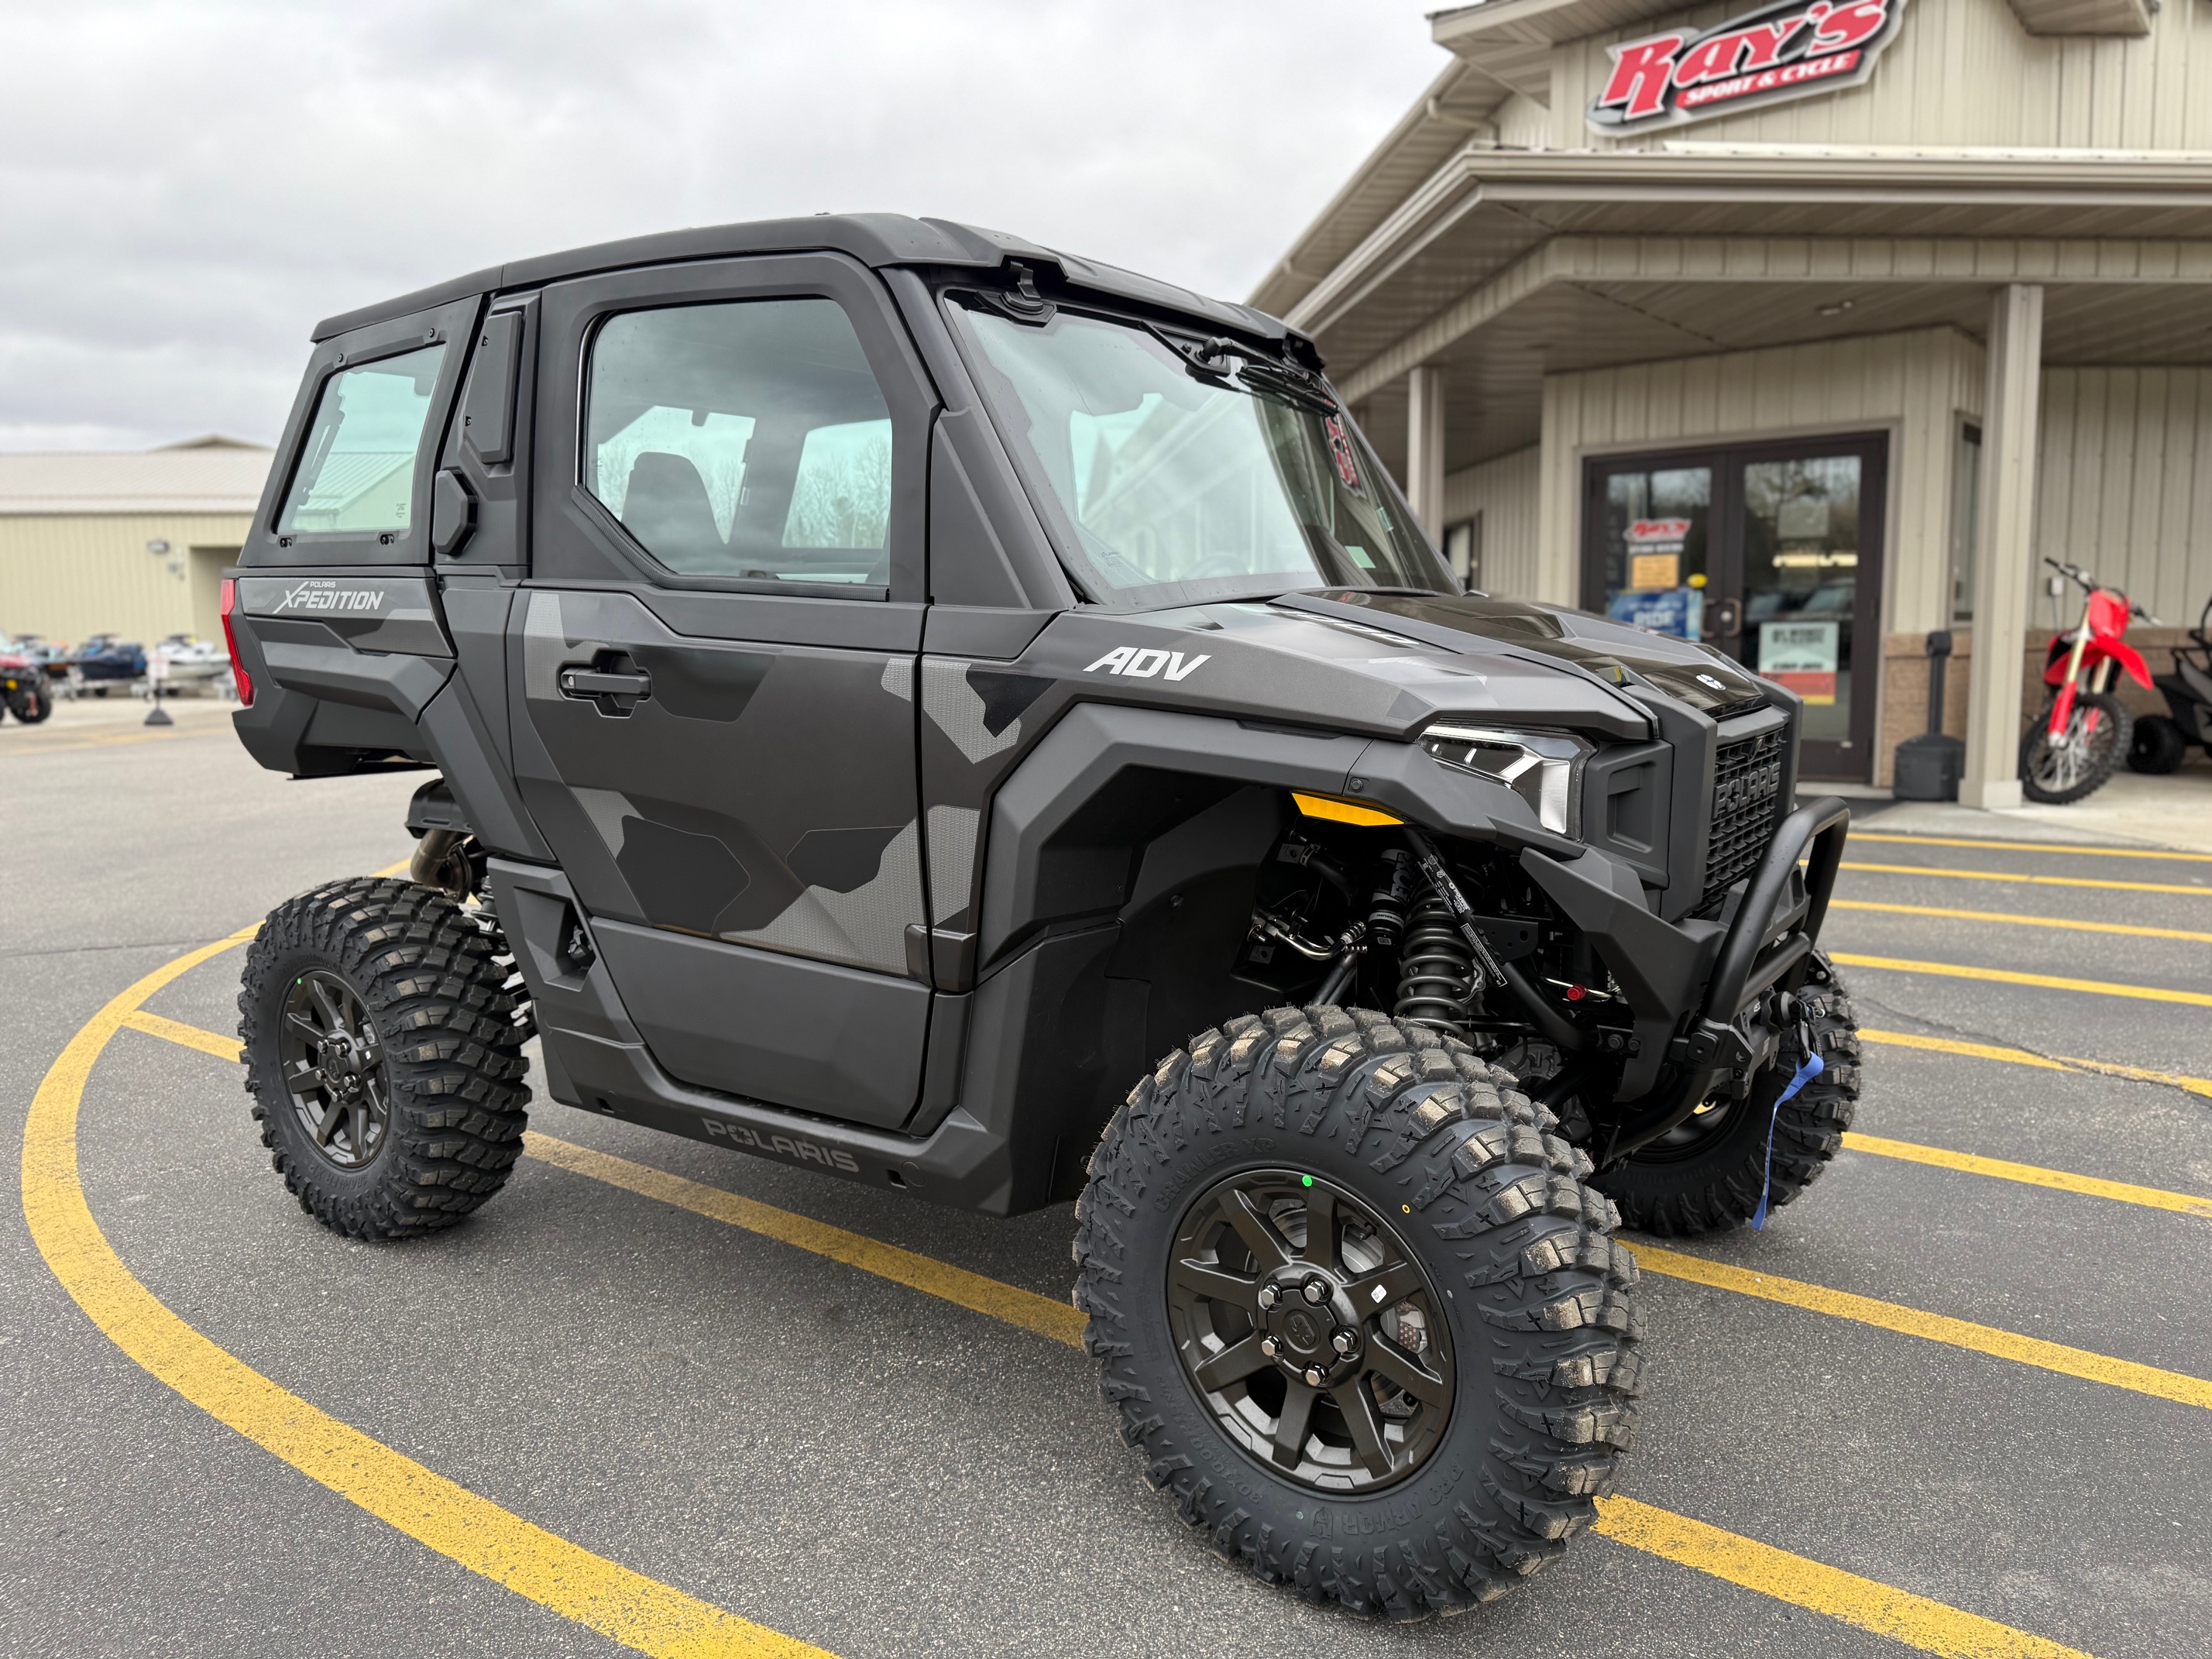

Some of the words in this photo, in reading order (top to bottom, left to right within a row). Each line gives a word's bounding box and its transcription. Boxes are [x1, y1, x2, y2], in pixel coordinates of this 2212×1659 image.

[1684, 76, 1755, 105] SPORT
[1757, 70, 1776, 88] &
[1781, 53, 1853, 82] CYCLE
[272, 581, 384, 614] XPEDITION
[1082, 646, 1212, 682] ADV
[1712, 761, 1781, 819] POLARIS
[1390, 852, 1414, 902] FOX
[701, 1116, 860, 1173] POLARIS
[1242, 1138, 1276, 1154] XP
